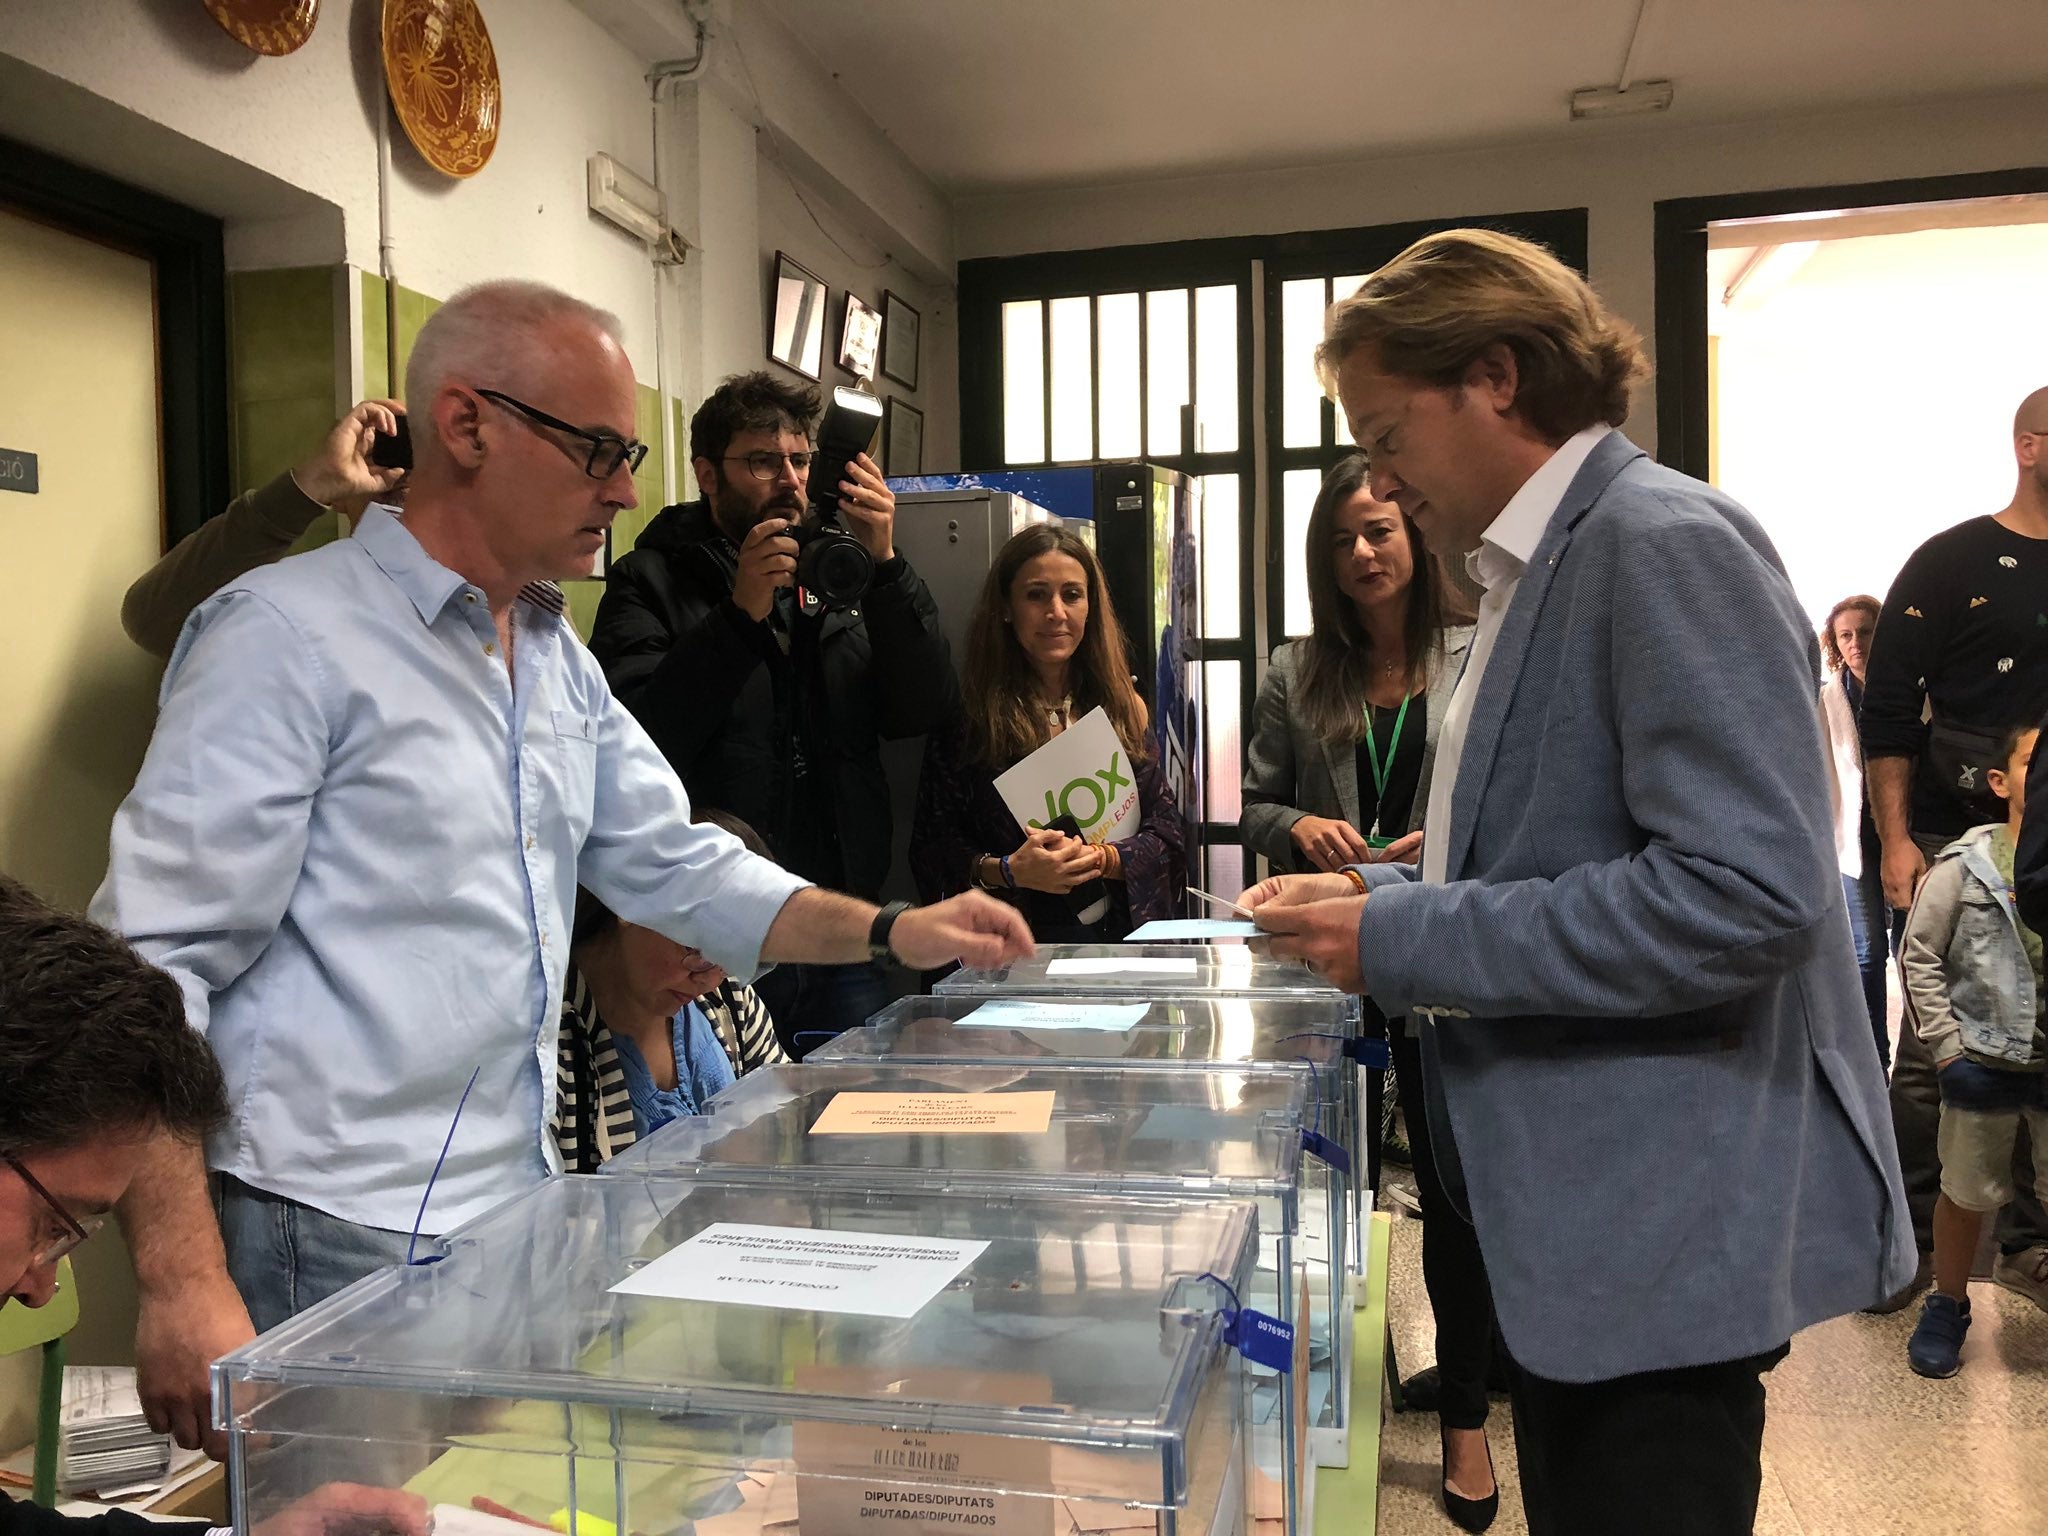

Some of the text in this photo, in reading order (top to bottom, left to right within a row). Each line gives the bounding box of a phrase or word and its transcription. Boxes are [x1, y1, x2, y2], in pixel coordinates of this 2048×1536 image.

[1028, 751, 1131, 828] VOX
[698, 1239, 958, 1261] CONSELLERES/CONSELLERS INSULARS
[711, 1234, 960, 1255] CONSEJERAS/CONSEJEROS INSULARES
[1257, 1320, 1291, 1341] 0076952
[865, 1490, 994, 1509] DIPUTADES/DIPUTATS
[860, 1507, 996, 1526] DIPUTADAS/DIPUTADOS
